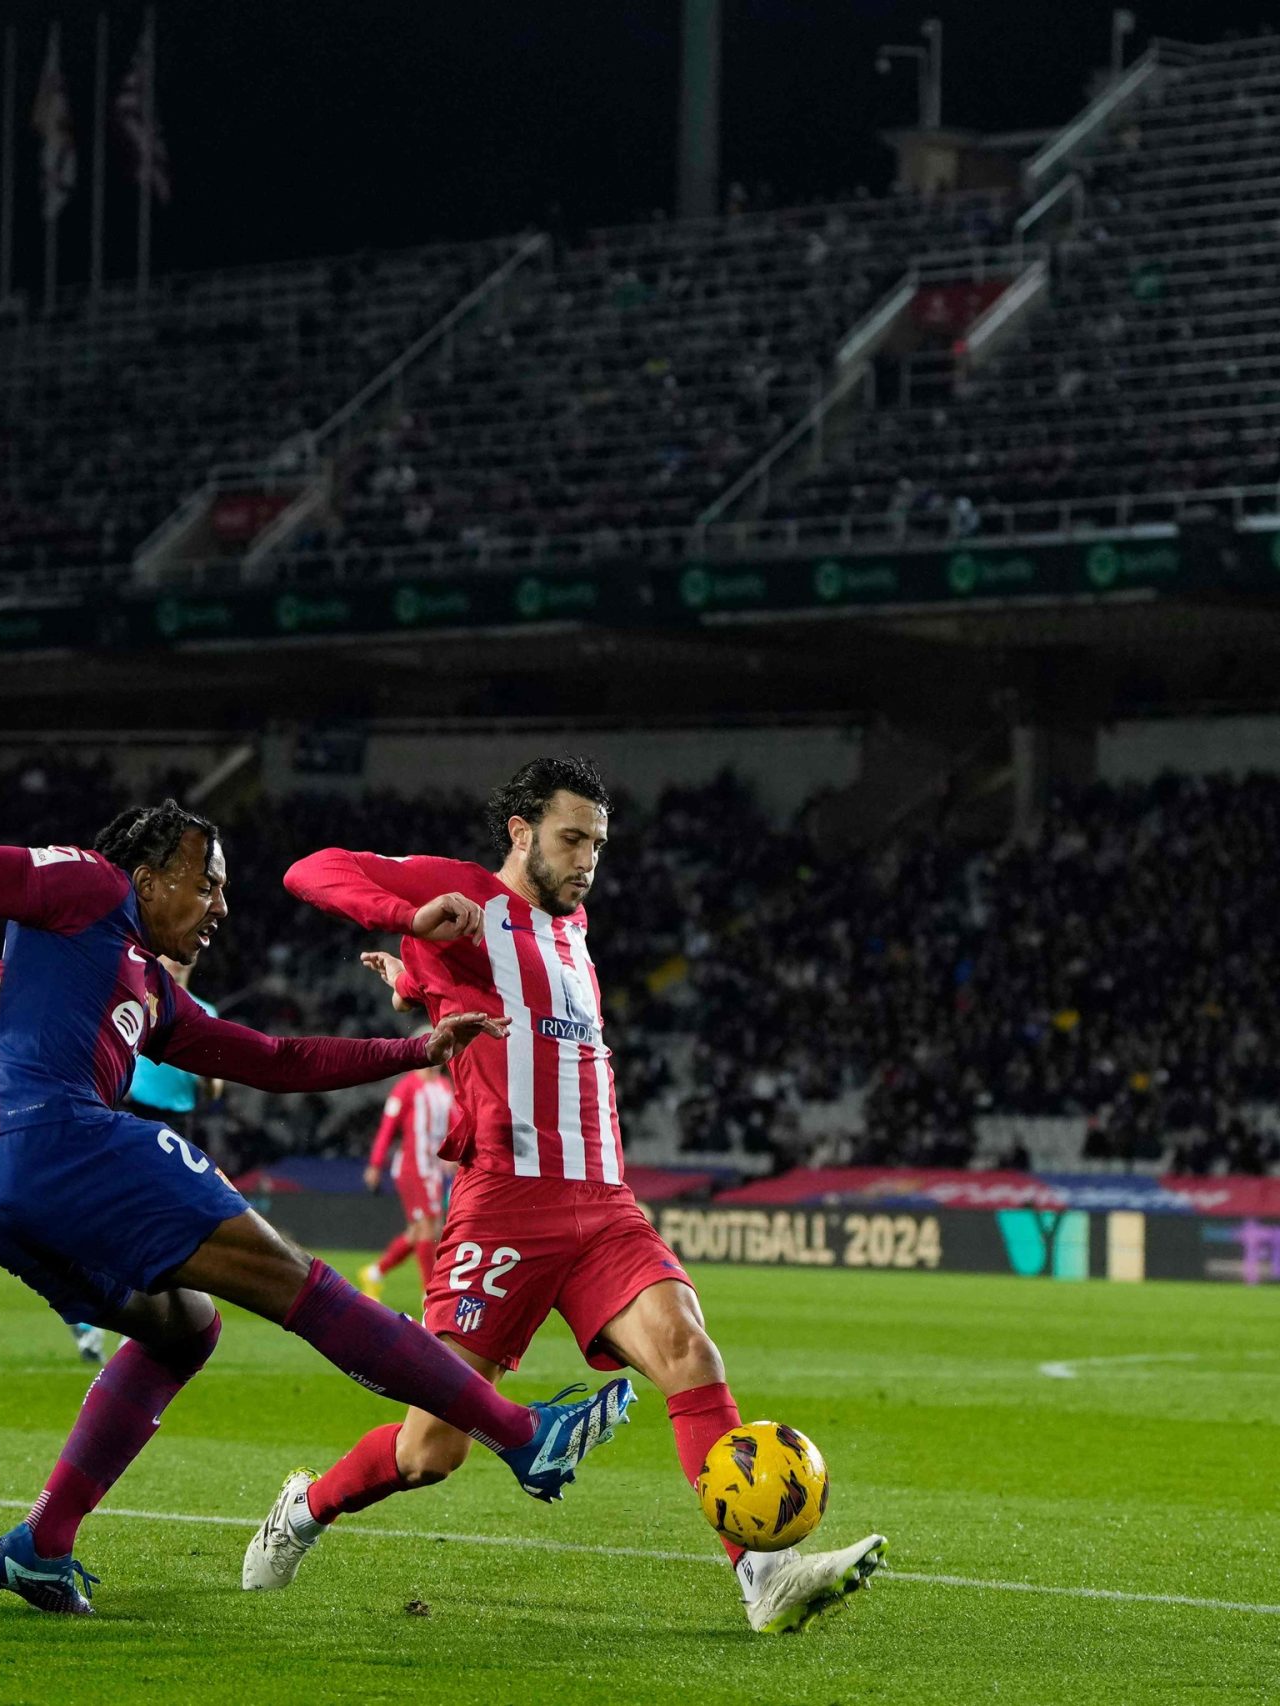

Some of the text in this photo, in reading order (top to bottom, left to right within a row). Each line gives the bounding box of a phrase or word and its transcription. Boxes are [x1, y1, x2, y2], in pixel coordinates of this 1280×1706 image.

[542, 1019, 594, 1042] RIYADH
[843, 1214, 941, 1269] 2024
[448, 1241, 521, 1299] 22
